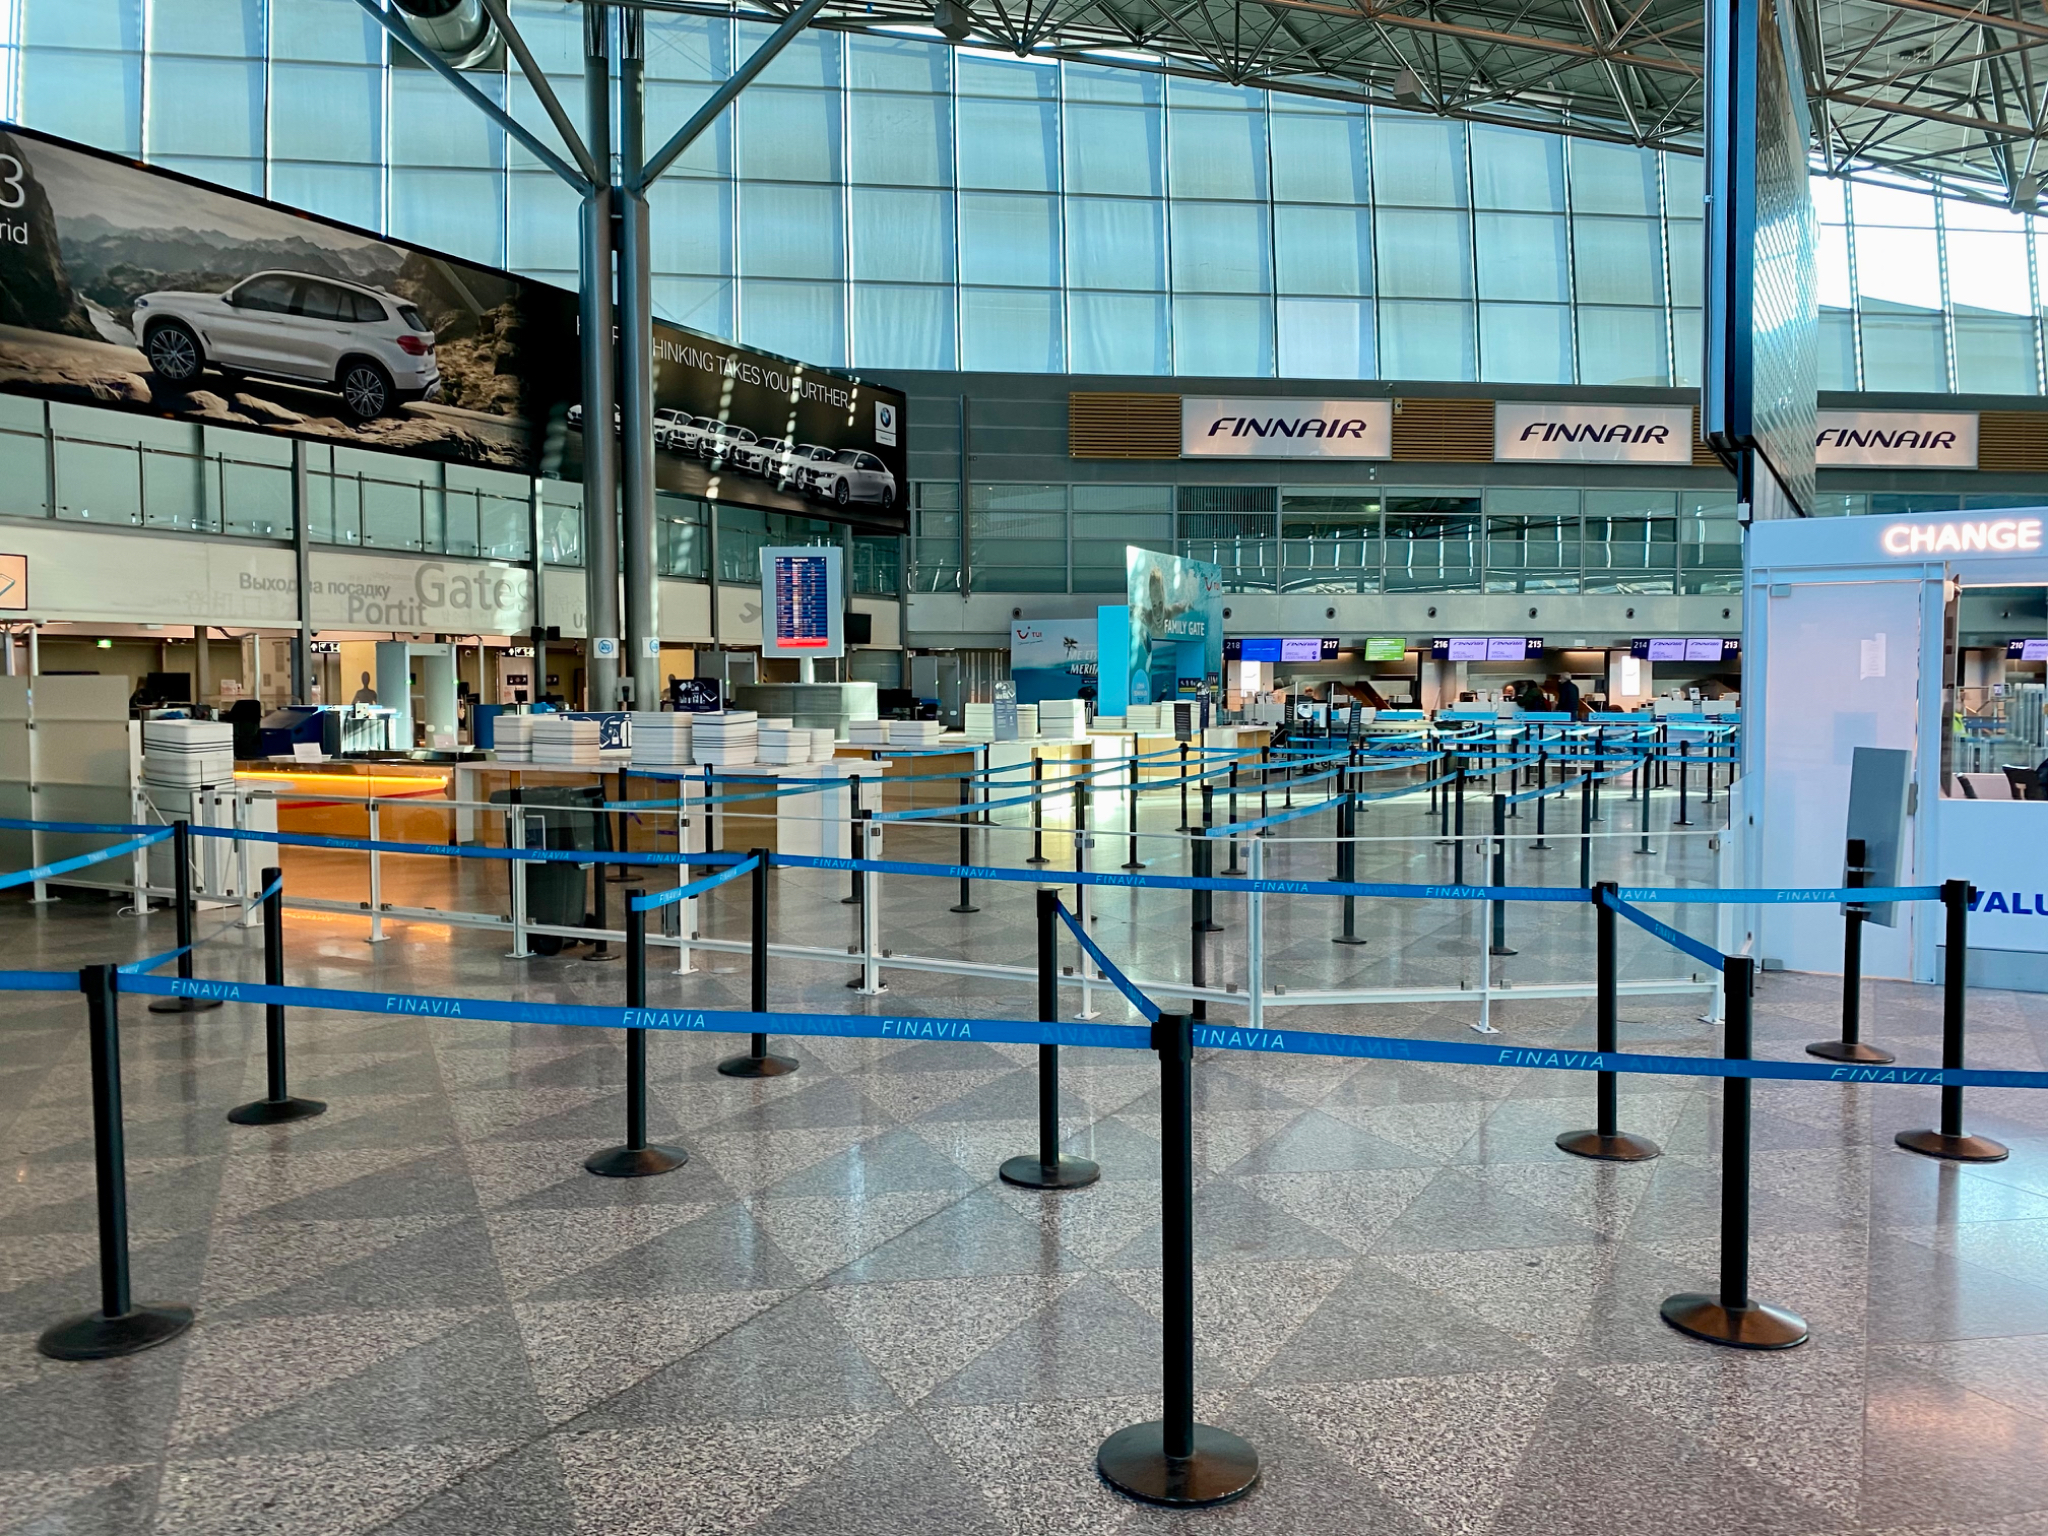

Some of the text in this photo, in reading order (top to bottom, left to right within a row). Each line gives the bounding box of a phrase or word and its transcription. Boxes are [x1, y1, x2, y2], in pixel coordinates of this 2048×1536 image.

[0, 153, 25, 208] 3
[653, 337, 713, 373] HINKING
[716, 355, 760, 386] TAKES
[762, 369, 789, 393] YOU
[1207, 417, 1367, 438] FINNAIR
[1519, 423, 1669, 444] FINNAIR
[1816, 429, 1956, 449] FINNAIR
[1884, 520, 2043, 553] CHANGE
[328, 582, 391, 601] посадку
[415, 563, 534, 612] Gates
[348, 594, 427, 626] Portit
[1164, 620, 1205, 636] FAMILY GATE
[1323, 641, 1338, 649] 217
[1433, 640, 1448, 648] 216
[1528, 640, 1542, 648] 215
[1633, 641, 1647, 649] 214
[1724, 640, 1738, 649] 213
[425, 845, 461, 855] FINAVIA
[532, 850, 569, 860] FINAVIA
[646, 854, 687, 863] FINAVIA
[813, 858, 858, 869] FINAVIA
[950, 867, 997, 878] FINAVIA
[1096, 874, 1147, 886] FINAVIA
[1253, 882, 1309, 893] FINAVIA
[1425, 887, 1486, 898] FINAVIA
[1617, 890, 1657, 900] AVIA
[1776, 891, 1837, 901] FINAVIA
[171, 980, 240, 998] FINAVIA
[386, 997, 461, 1015] FINAVIA
[622, 1011, 705, 1028] FINAVIA
[882, 1020, 971, 1038] FINAVIA
[1498, 1050, 1604, 1068] FINAVIA
[1830, 1067, 1944, 1084] FINAVIA
